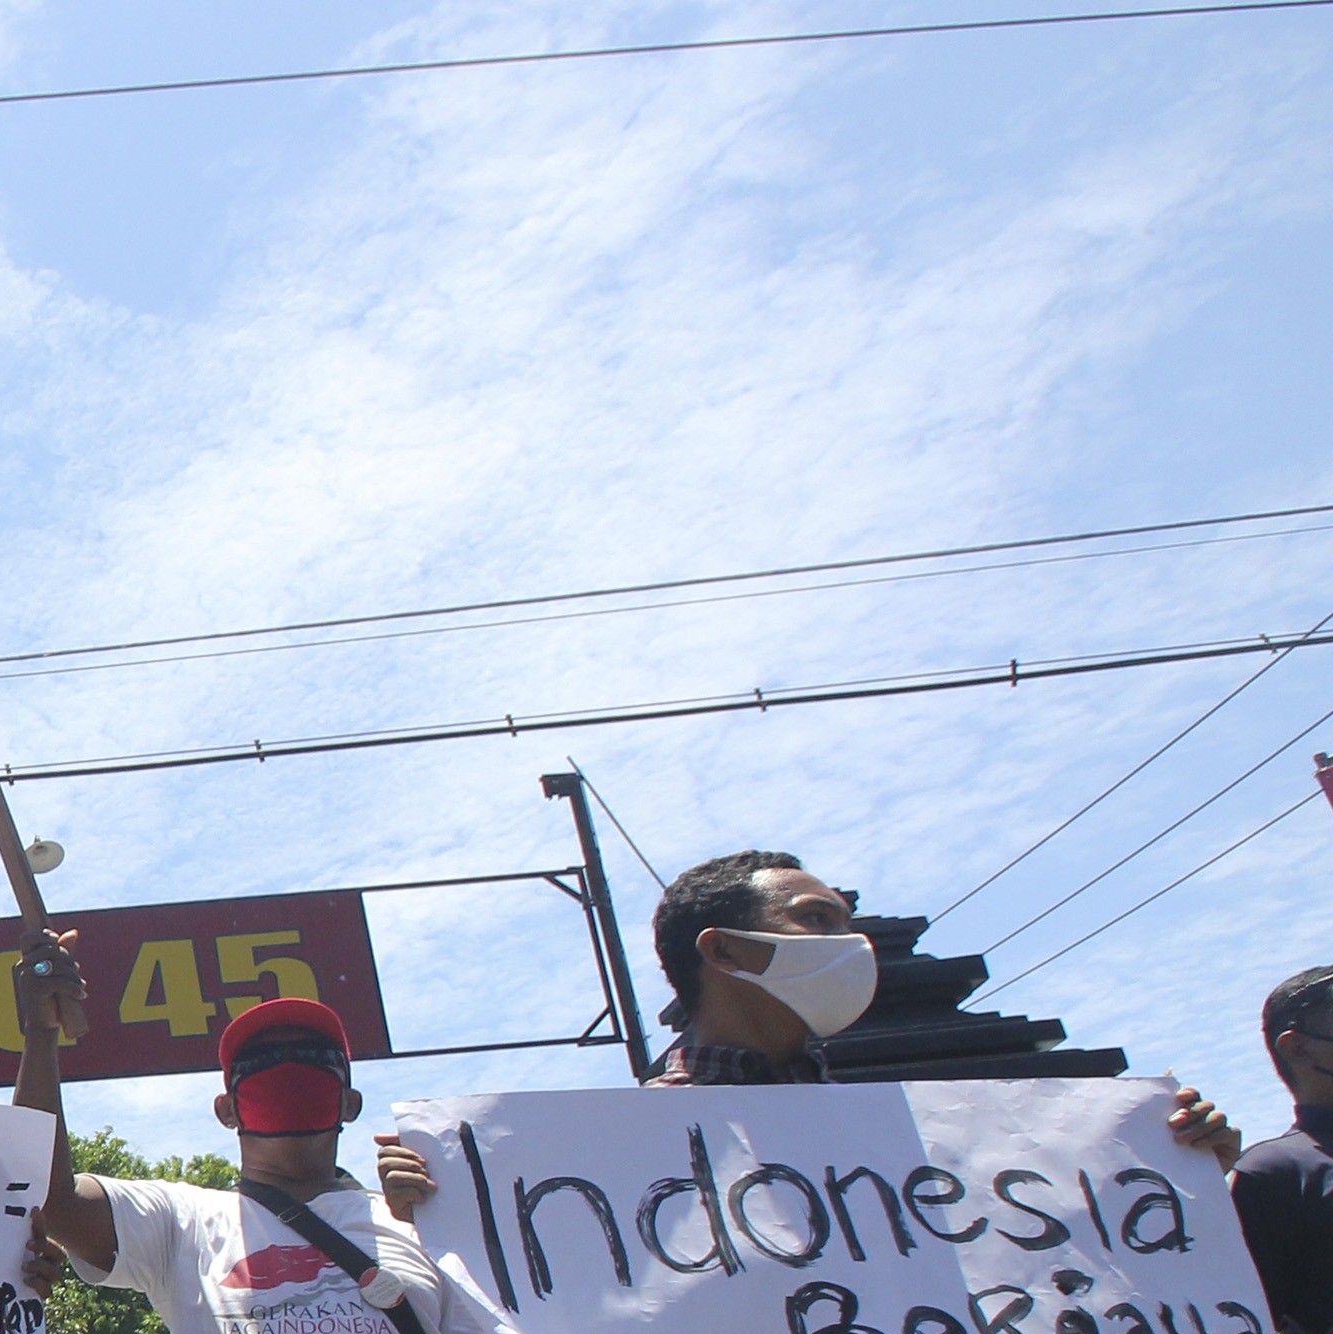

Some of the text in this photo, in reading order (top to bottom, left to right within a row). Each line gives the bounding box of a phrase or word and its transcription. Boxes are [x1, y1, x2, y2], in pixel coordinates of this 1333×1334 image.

[119, 930, 321, 1038] 45
[459, 1120, 1197, 1313] Indonesia
[250, 1301, 364, 1320] GERAKAN
